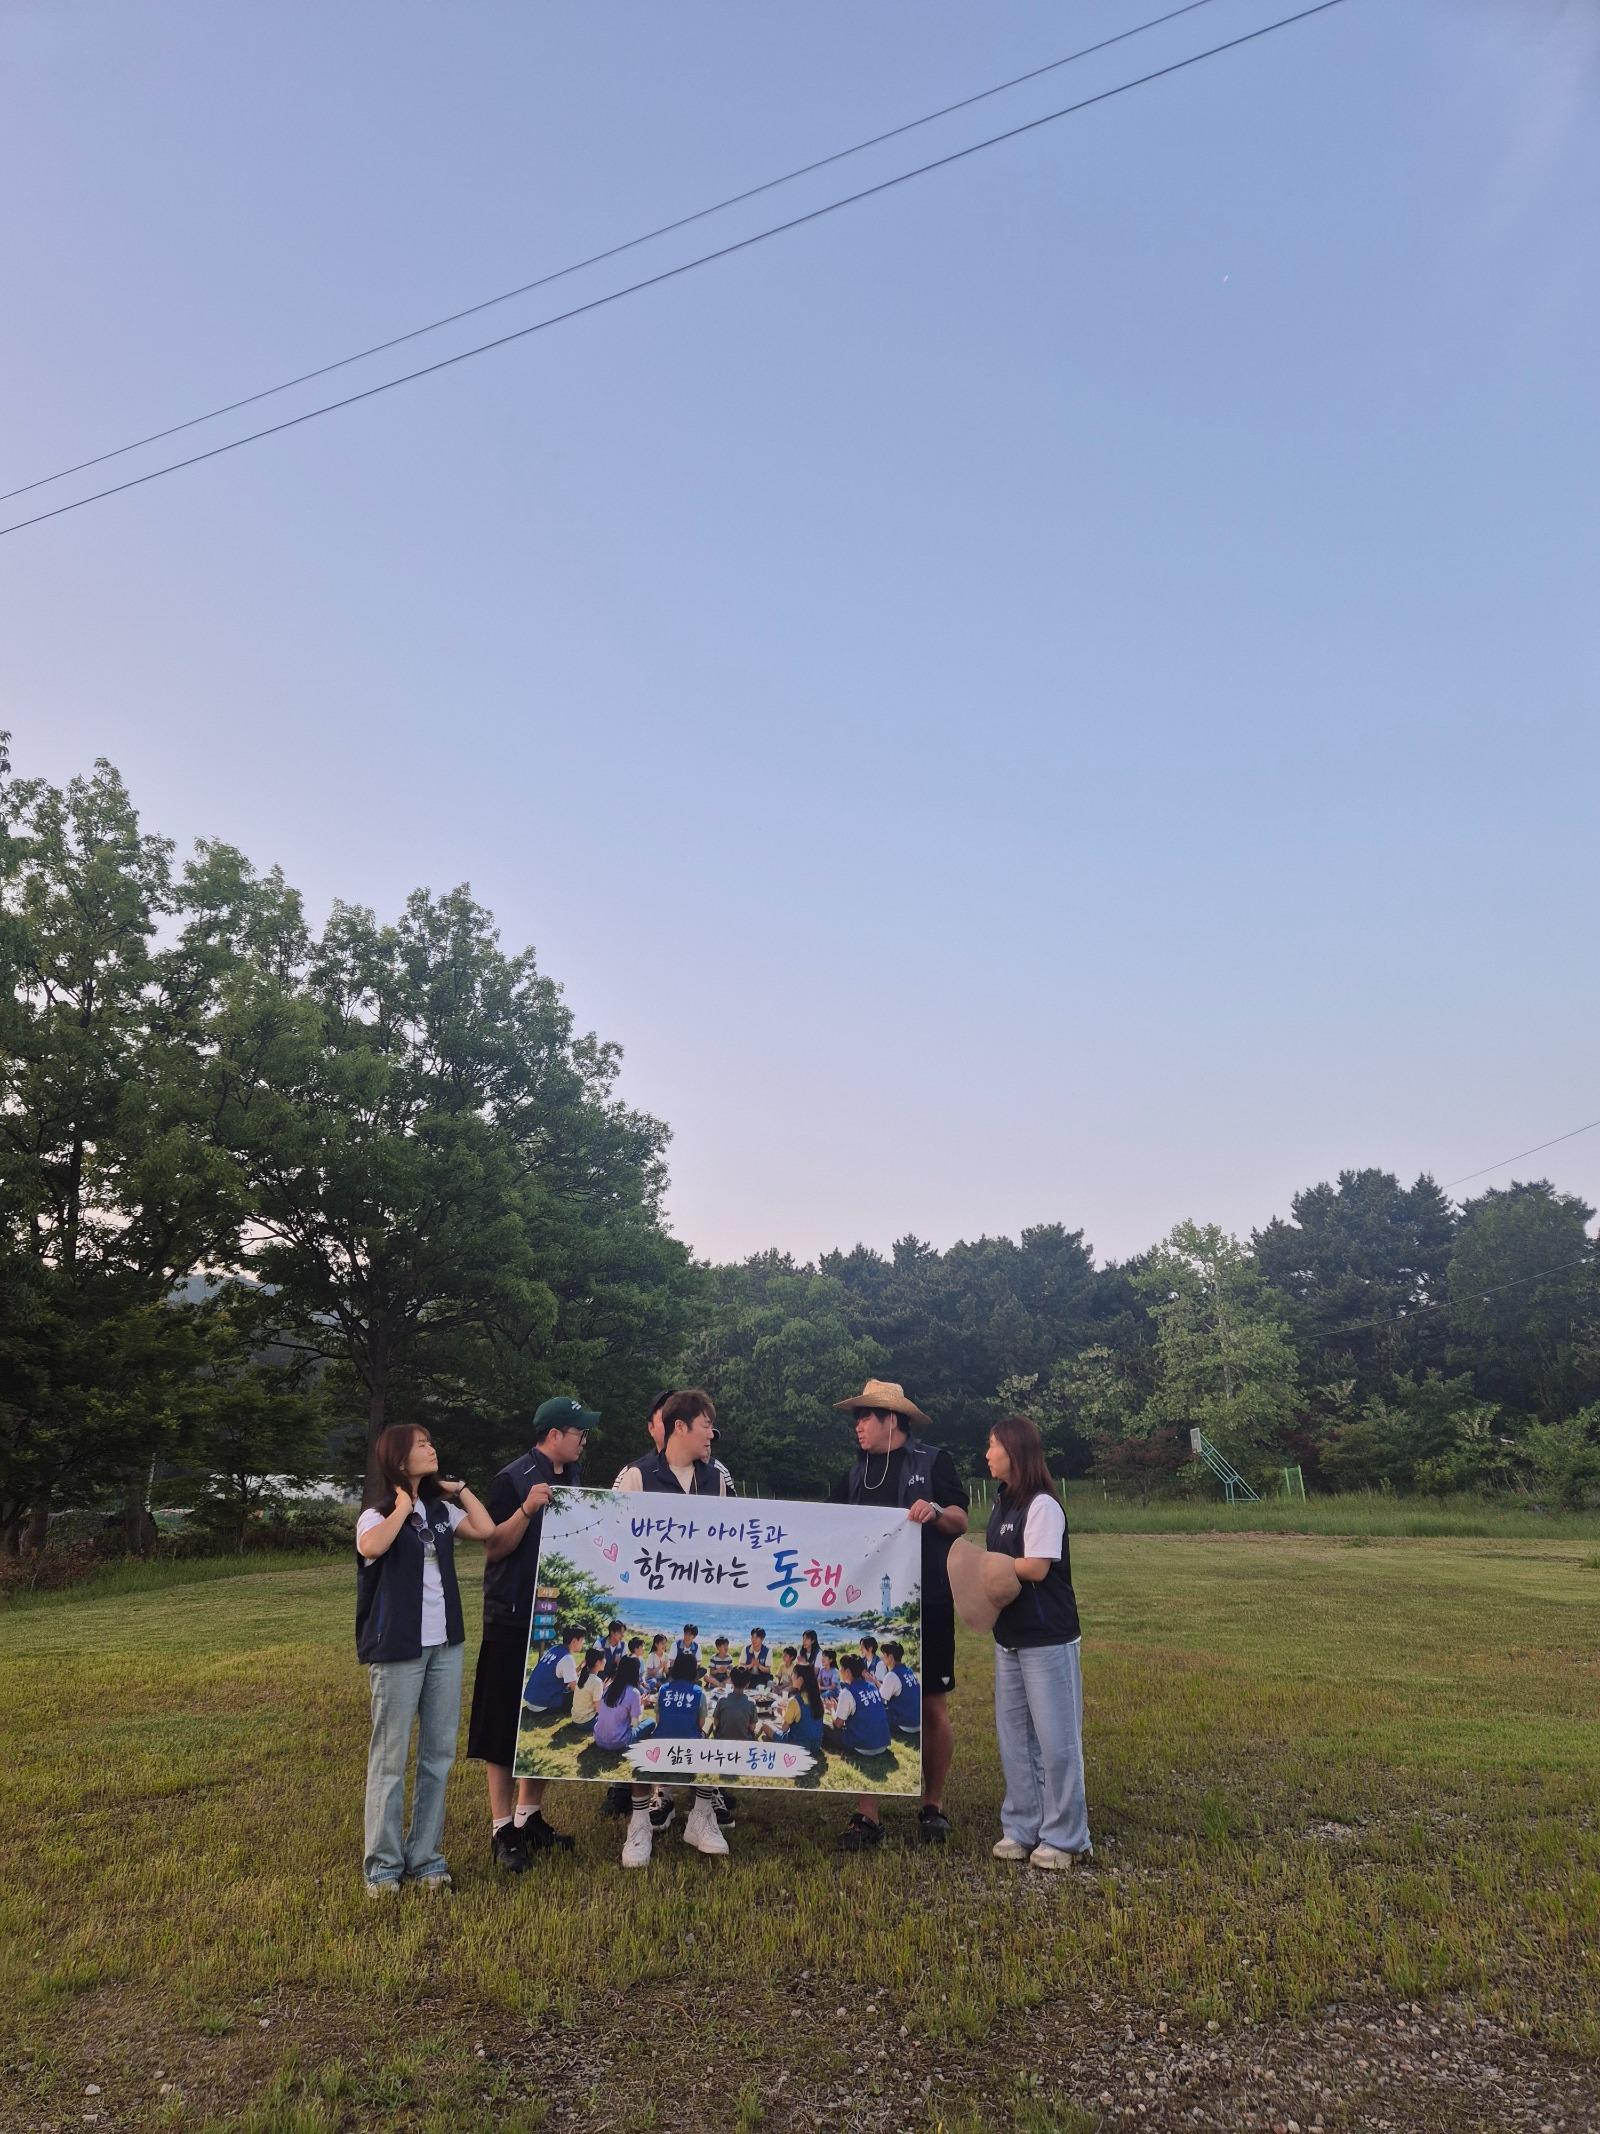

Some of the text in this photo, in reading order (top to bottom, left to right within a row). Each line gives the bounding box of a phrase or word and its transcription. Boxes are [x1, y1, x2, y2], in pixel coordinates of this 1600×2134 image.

[631, 1517, 788, 1549] 바닷가 아이들과
[634, 1547, 843, 1608] 함께하는 동행
[663, 1690, 685, 1708] 동행
[667, 1745, 776, 1770] 삶을 나누다 동행
